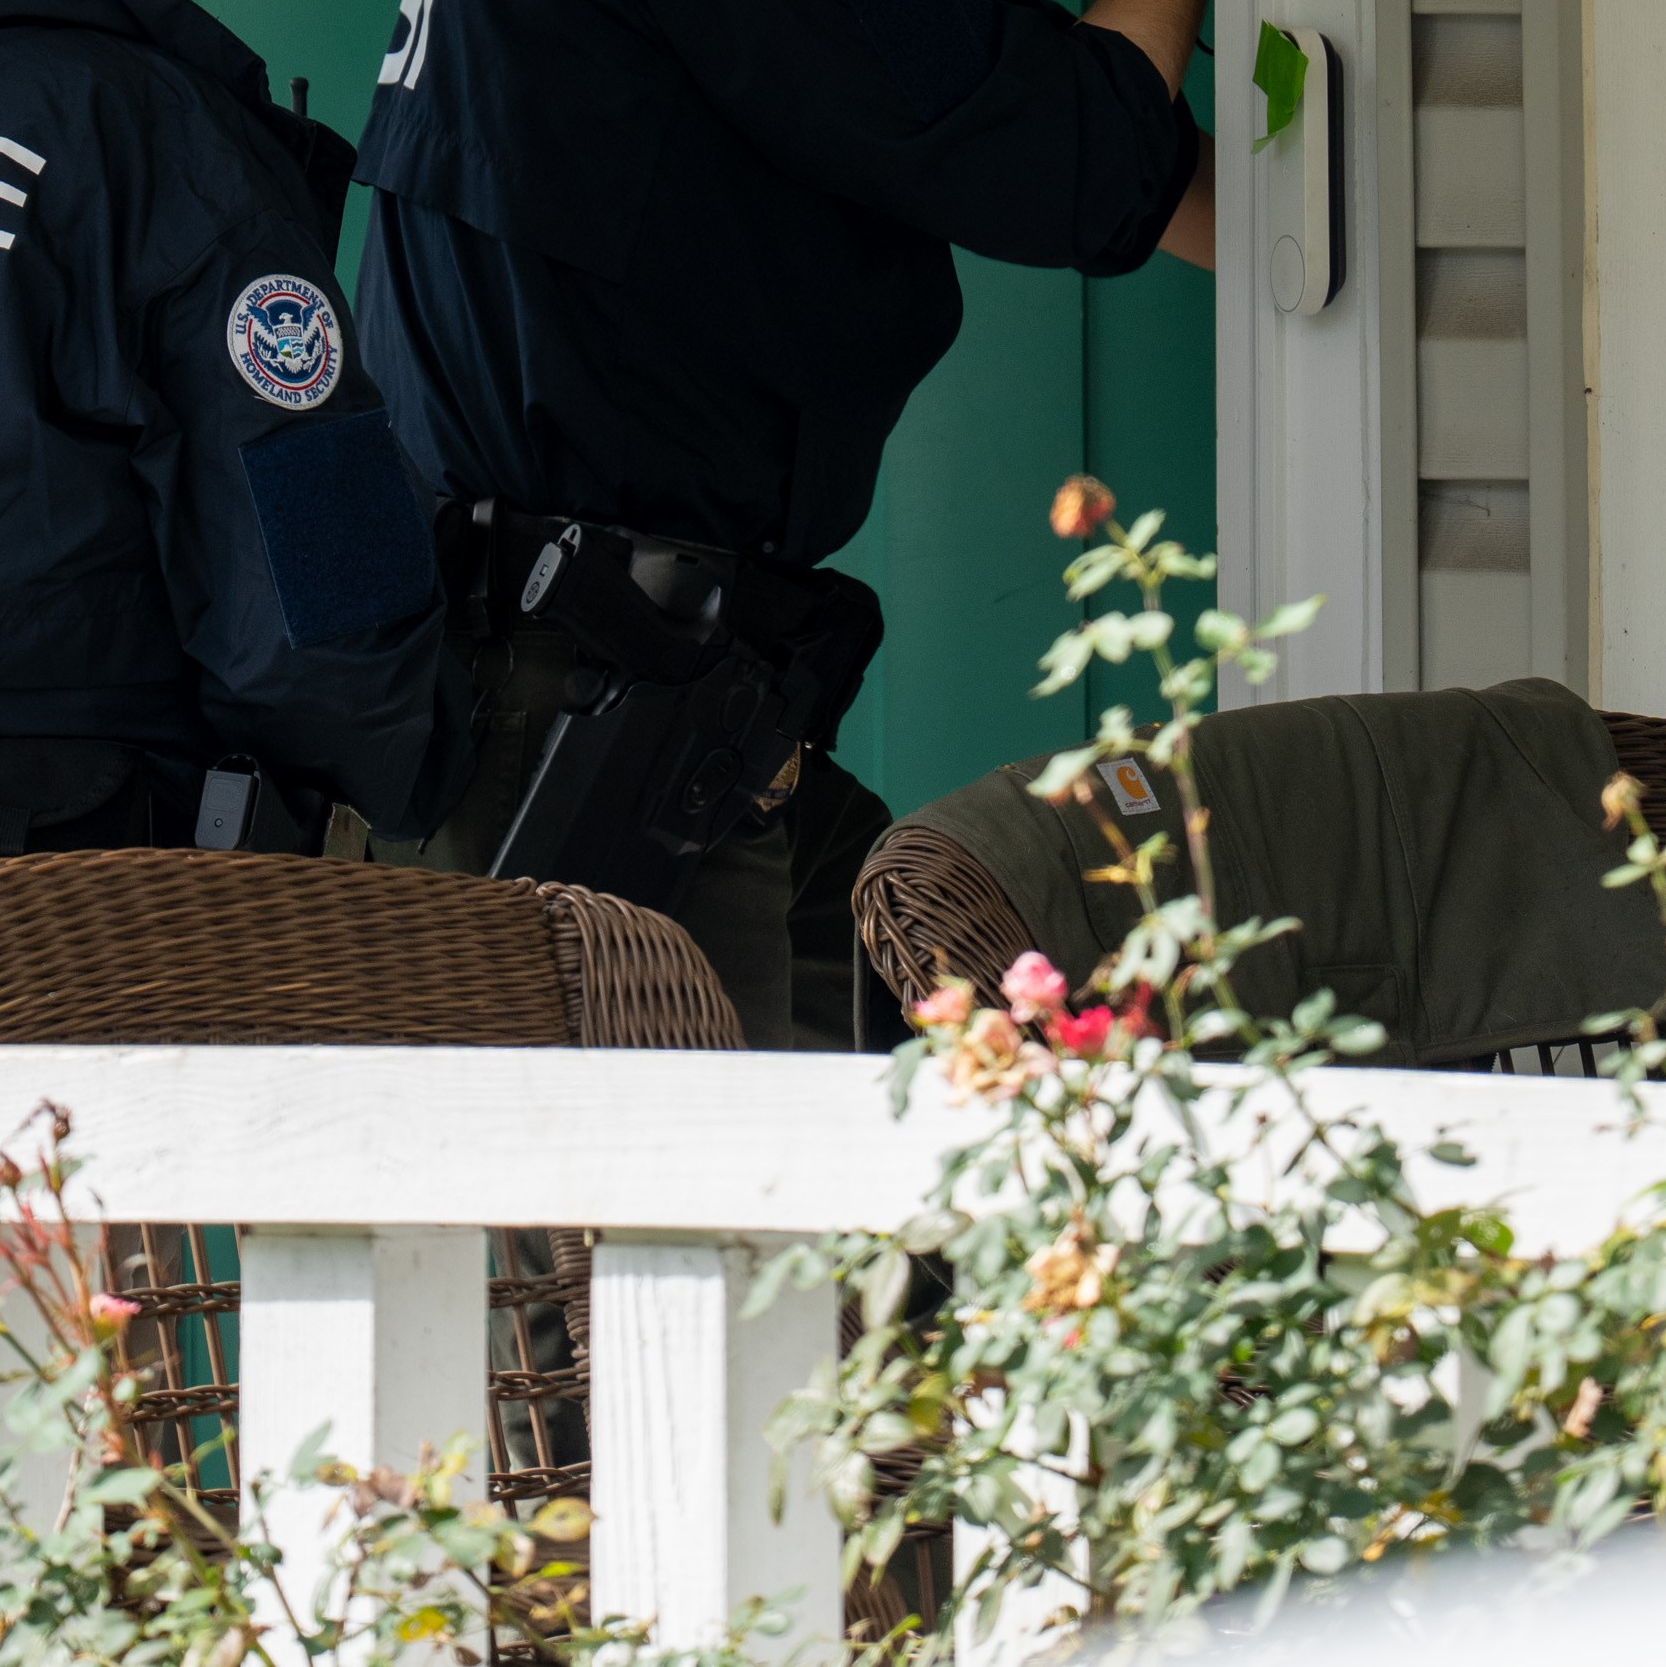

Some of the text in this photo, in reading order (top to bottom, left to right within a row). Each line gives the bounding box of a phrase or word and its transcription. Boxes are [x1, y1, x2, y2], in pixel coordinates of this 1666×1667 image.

[236, 280, 334, 335] U.S. DEPARTMENT OF
[240, 343, 338, 404] HOMELAND SECURITY
